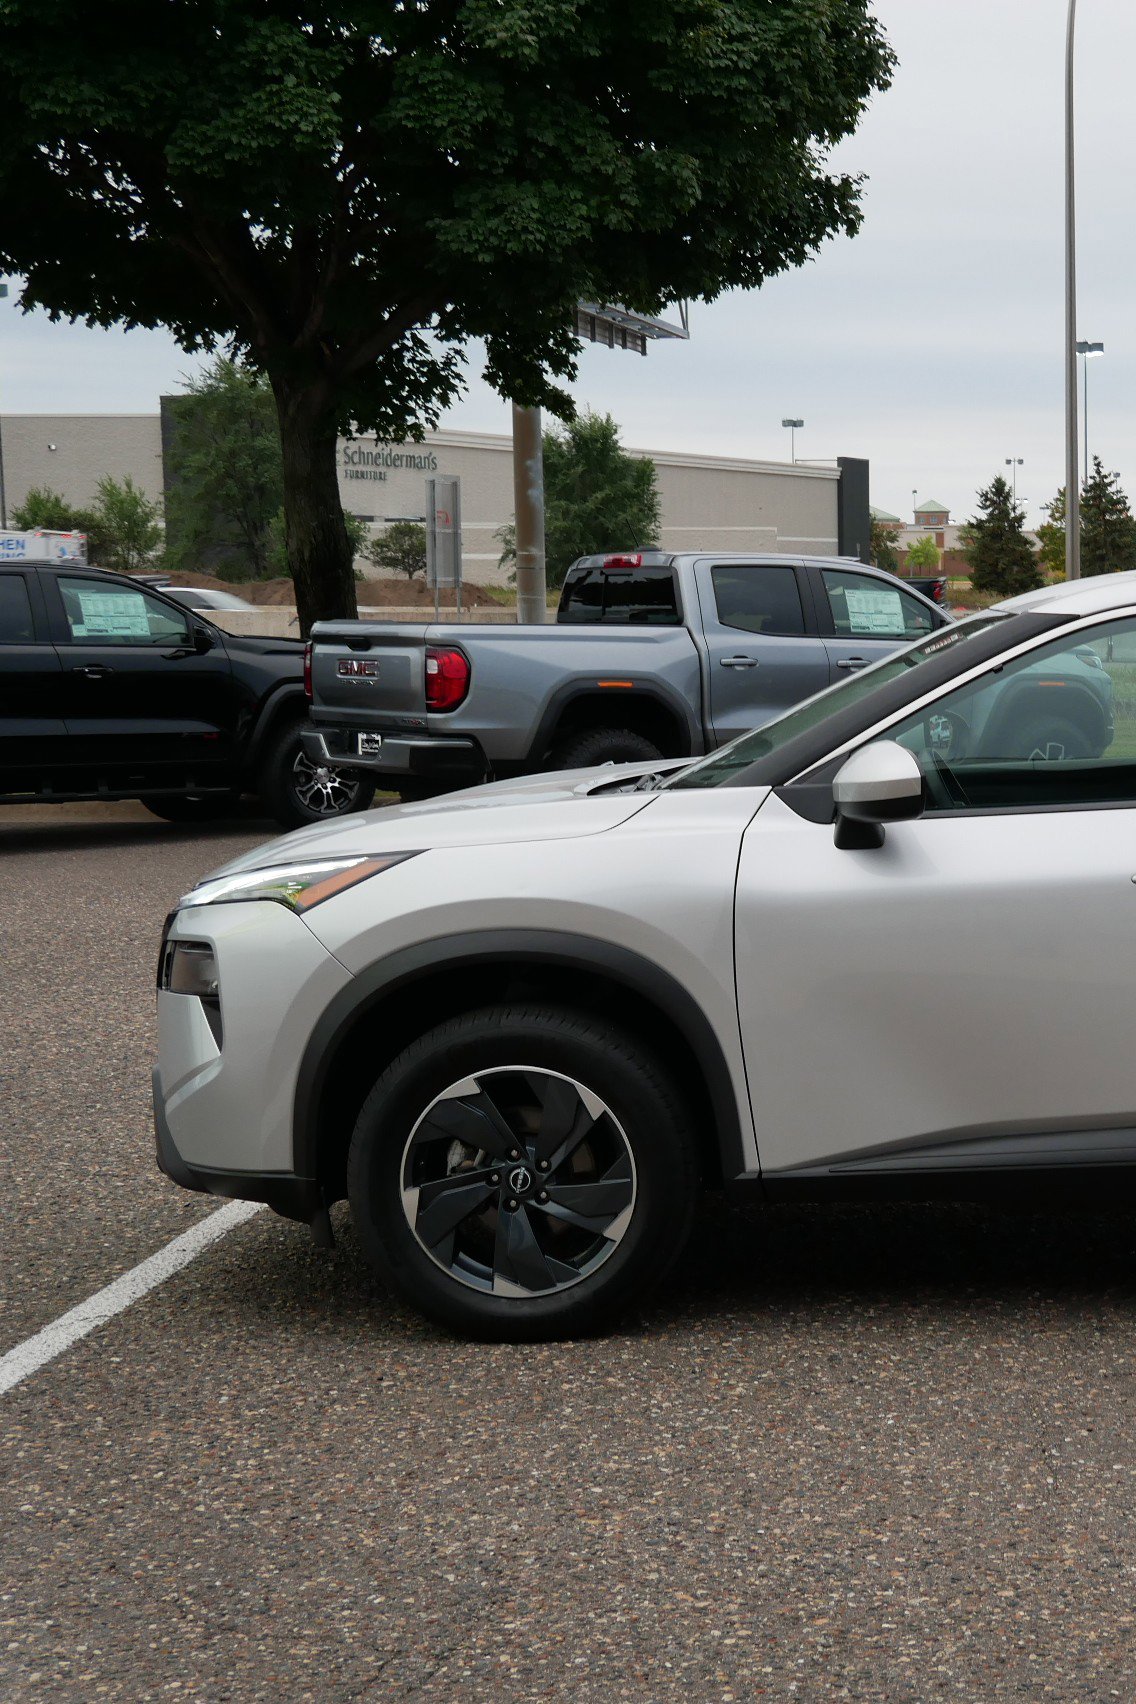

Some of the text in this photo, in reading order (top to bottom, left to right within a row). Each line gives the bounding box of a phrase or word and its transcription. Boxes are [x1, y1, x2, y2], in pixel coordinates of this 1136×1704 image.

[343, 446, 438, 471] Schneiderman's
[344, 469, 388, 481] FURNITURE
[338, 660, 378, 676] GMC
